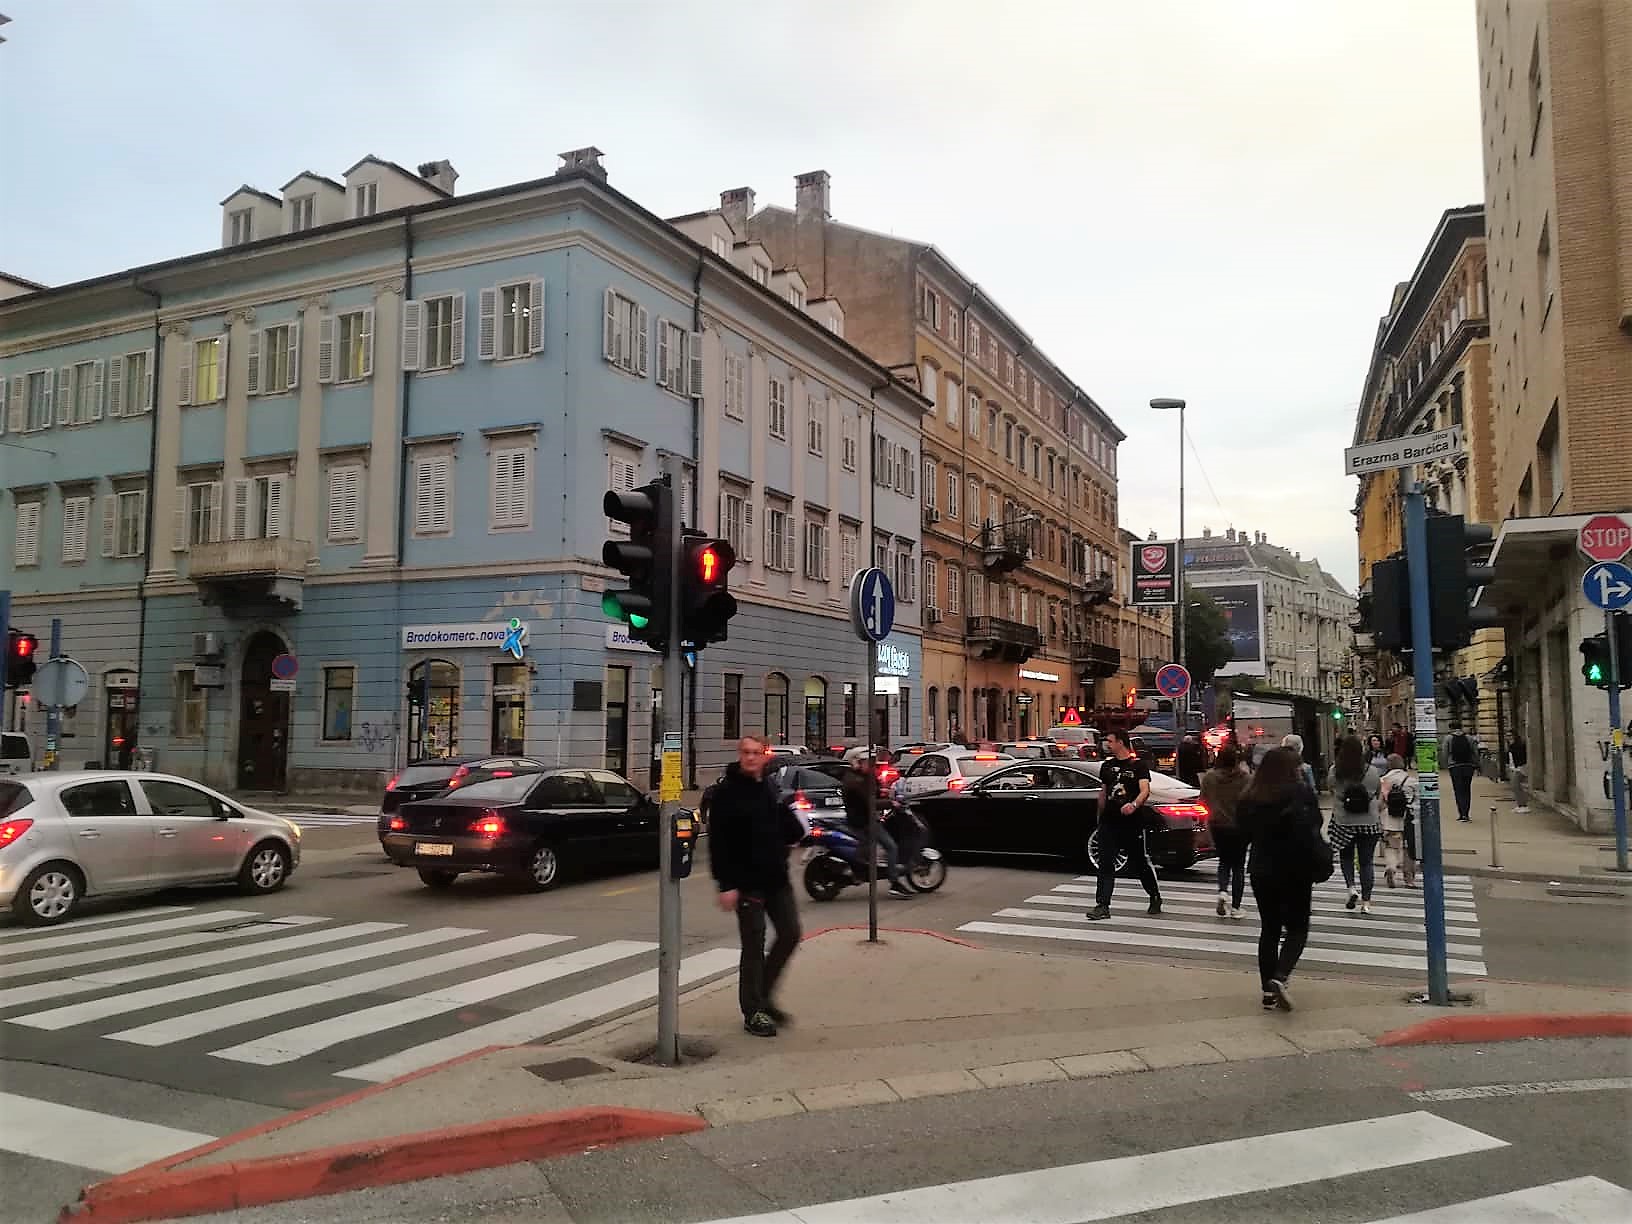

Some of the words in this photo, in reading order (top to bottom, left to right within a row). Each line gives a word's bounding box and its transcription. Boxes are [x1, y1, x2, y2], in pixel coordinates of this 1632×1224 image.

[1352, 452, 1400, 468] Erazma
[1583, 528, 1629, 547] STOP
[406, 630, 505, 643] Brodokomerc.nova
